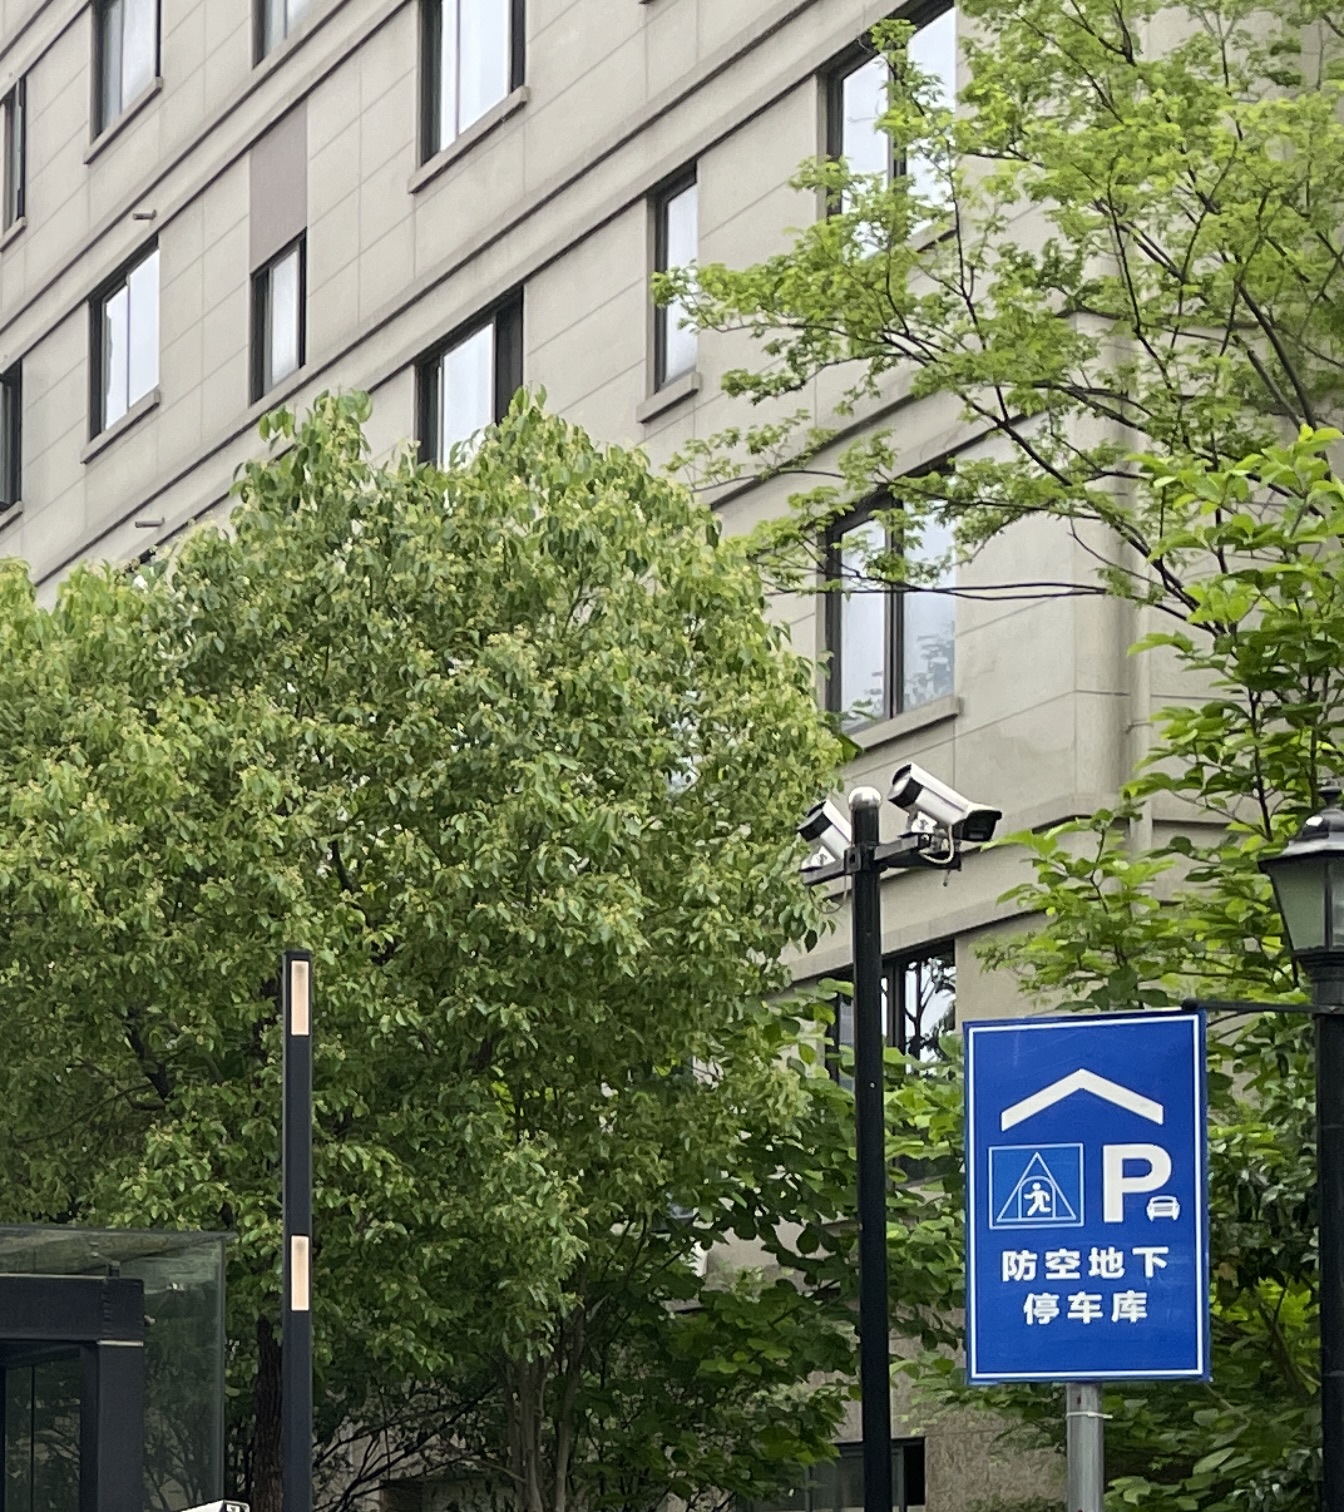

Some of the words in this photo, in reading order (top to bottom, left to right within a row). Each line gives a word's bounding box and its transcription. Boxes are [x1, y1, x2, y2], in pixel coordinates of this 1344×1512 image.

[1102, 1143, 1172, 1223] P
[1001, 1246, 1170, 1282] 防空地下
[1022, 1289, 1149, 1325] 停车库
